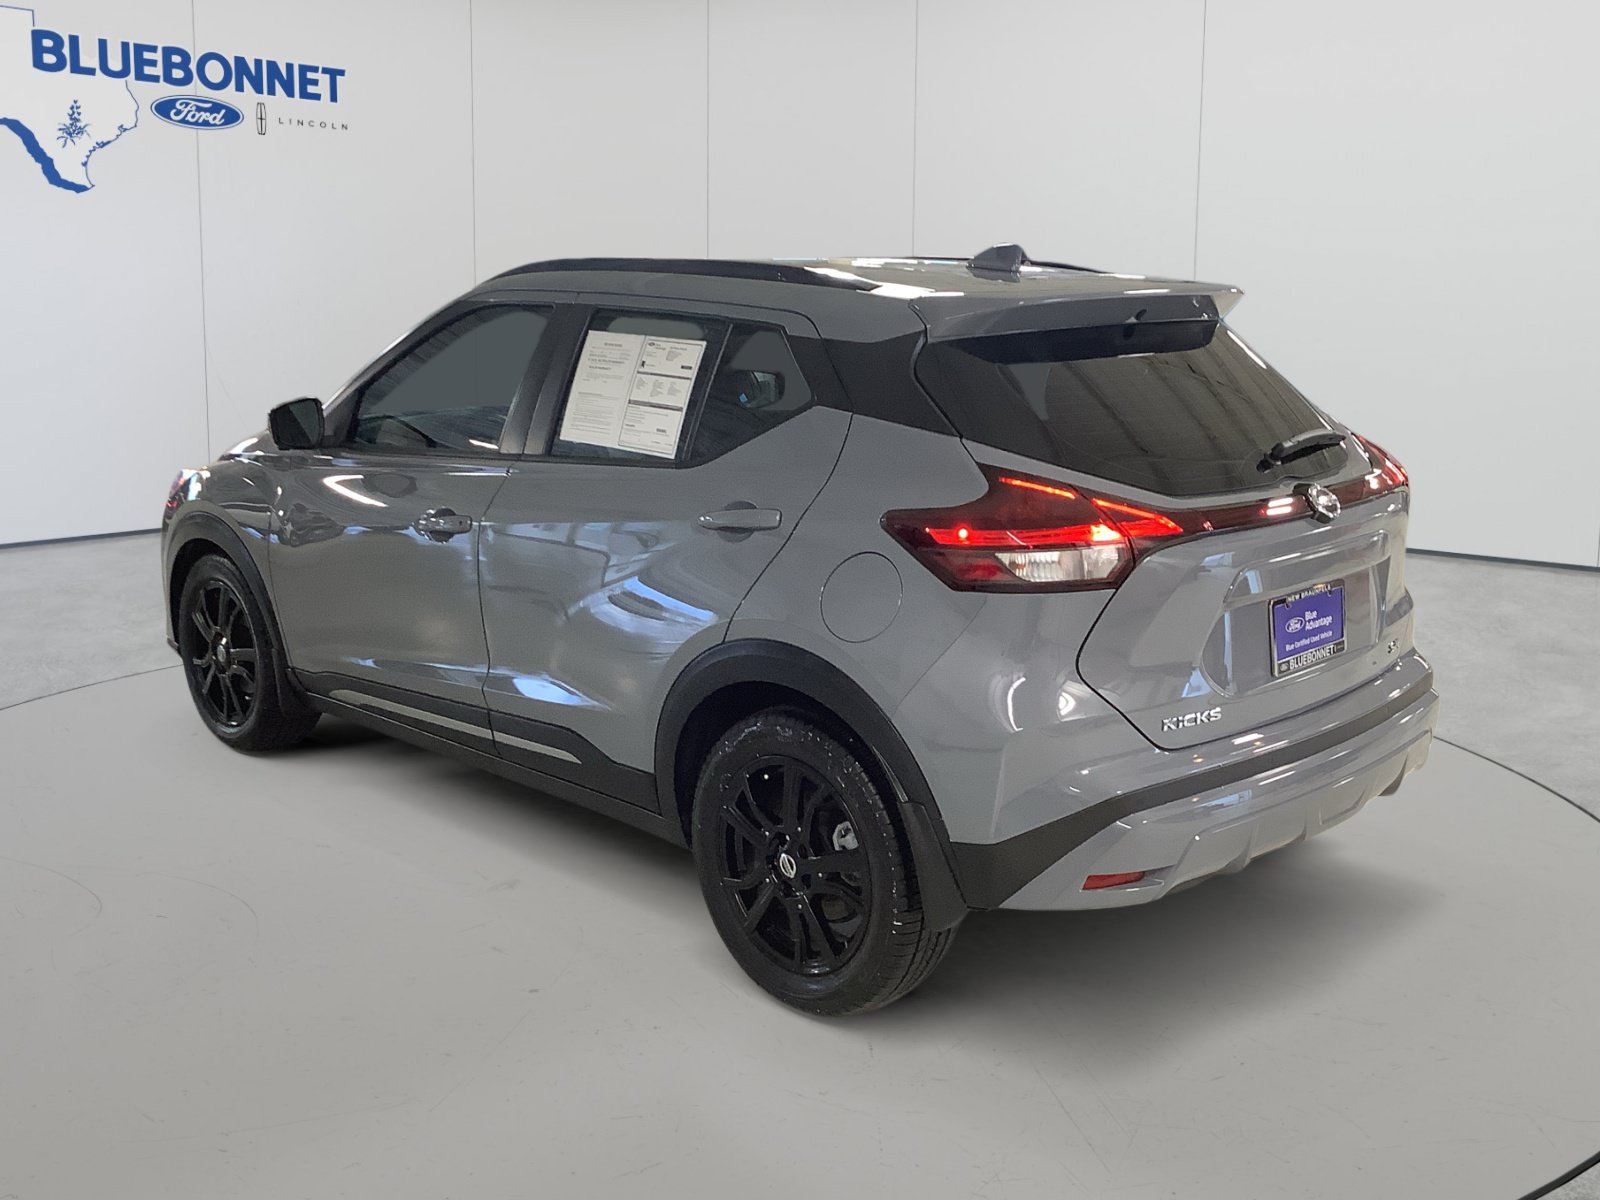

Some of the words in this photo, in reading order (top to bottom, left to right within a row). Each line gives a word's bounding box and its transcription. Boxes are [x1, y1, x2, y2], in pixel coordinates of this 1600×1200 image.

[31, 29, 346, 103] BLUEBONNET
[170, 99, 226, 126] Ford
[278, 117, 349, 130] LINCOLN
[1305, 610, 1317, 620] Blue
[1305, 616, 1333, 631] Advantage
[1286, 643, 1295, 652] Blue
[1295, 638, 1310, 649] Certified
[1310, 634, 1320, 643] Used
[1320, 631, 1333, 639] Vehicle
[1289, 645, 1335, 670] BLUEBONNET
